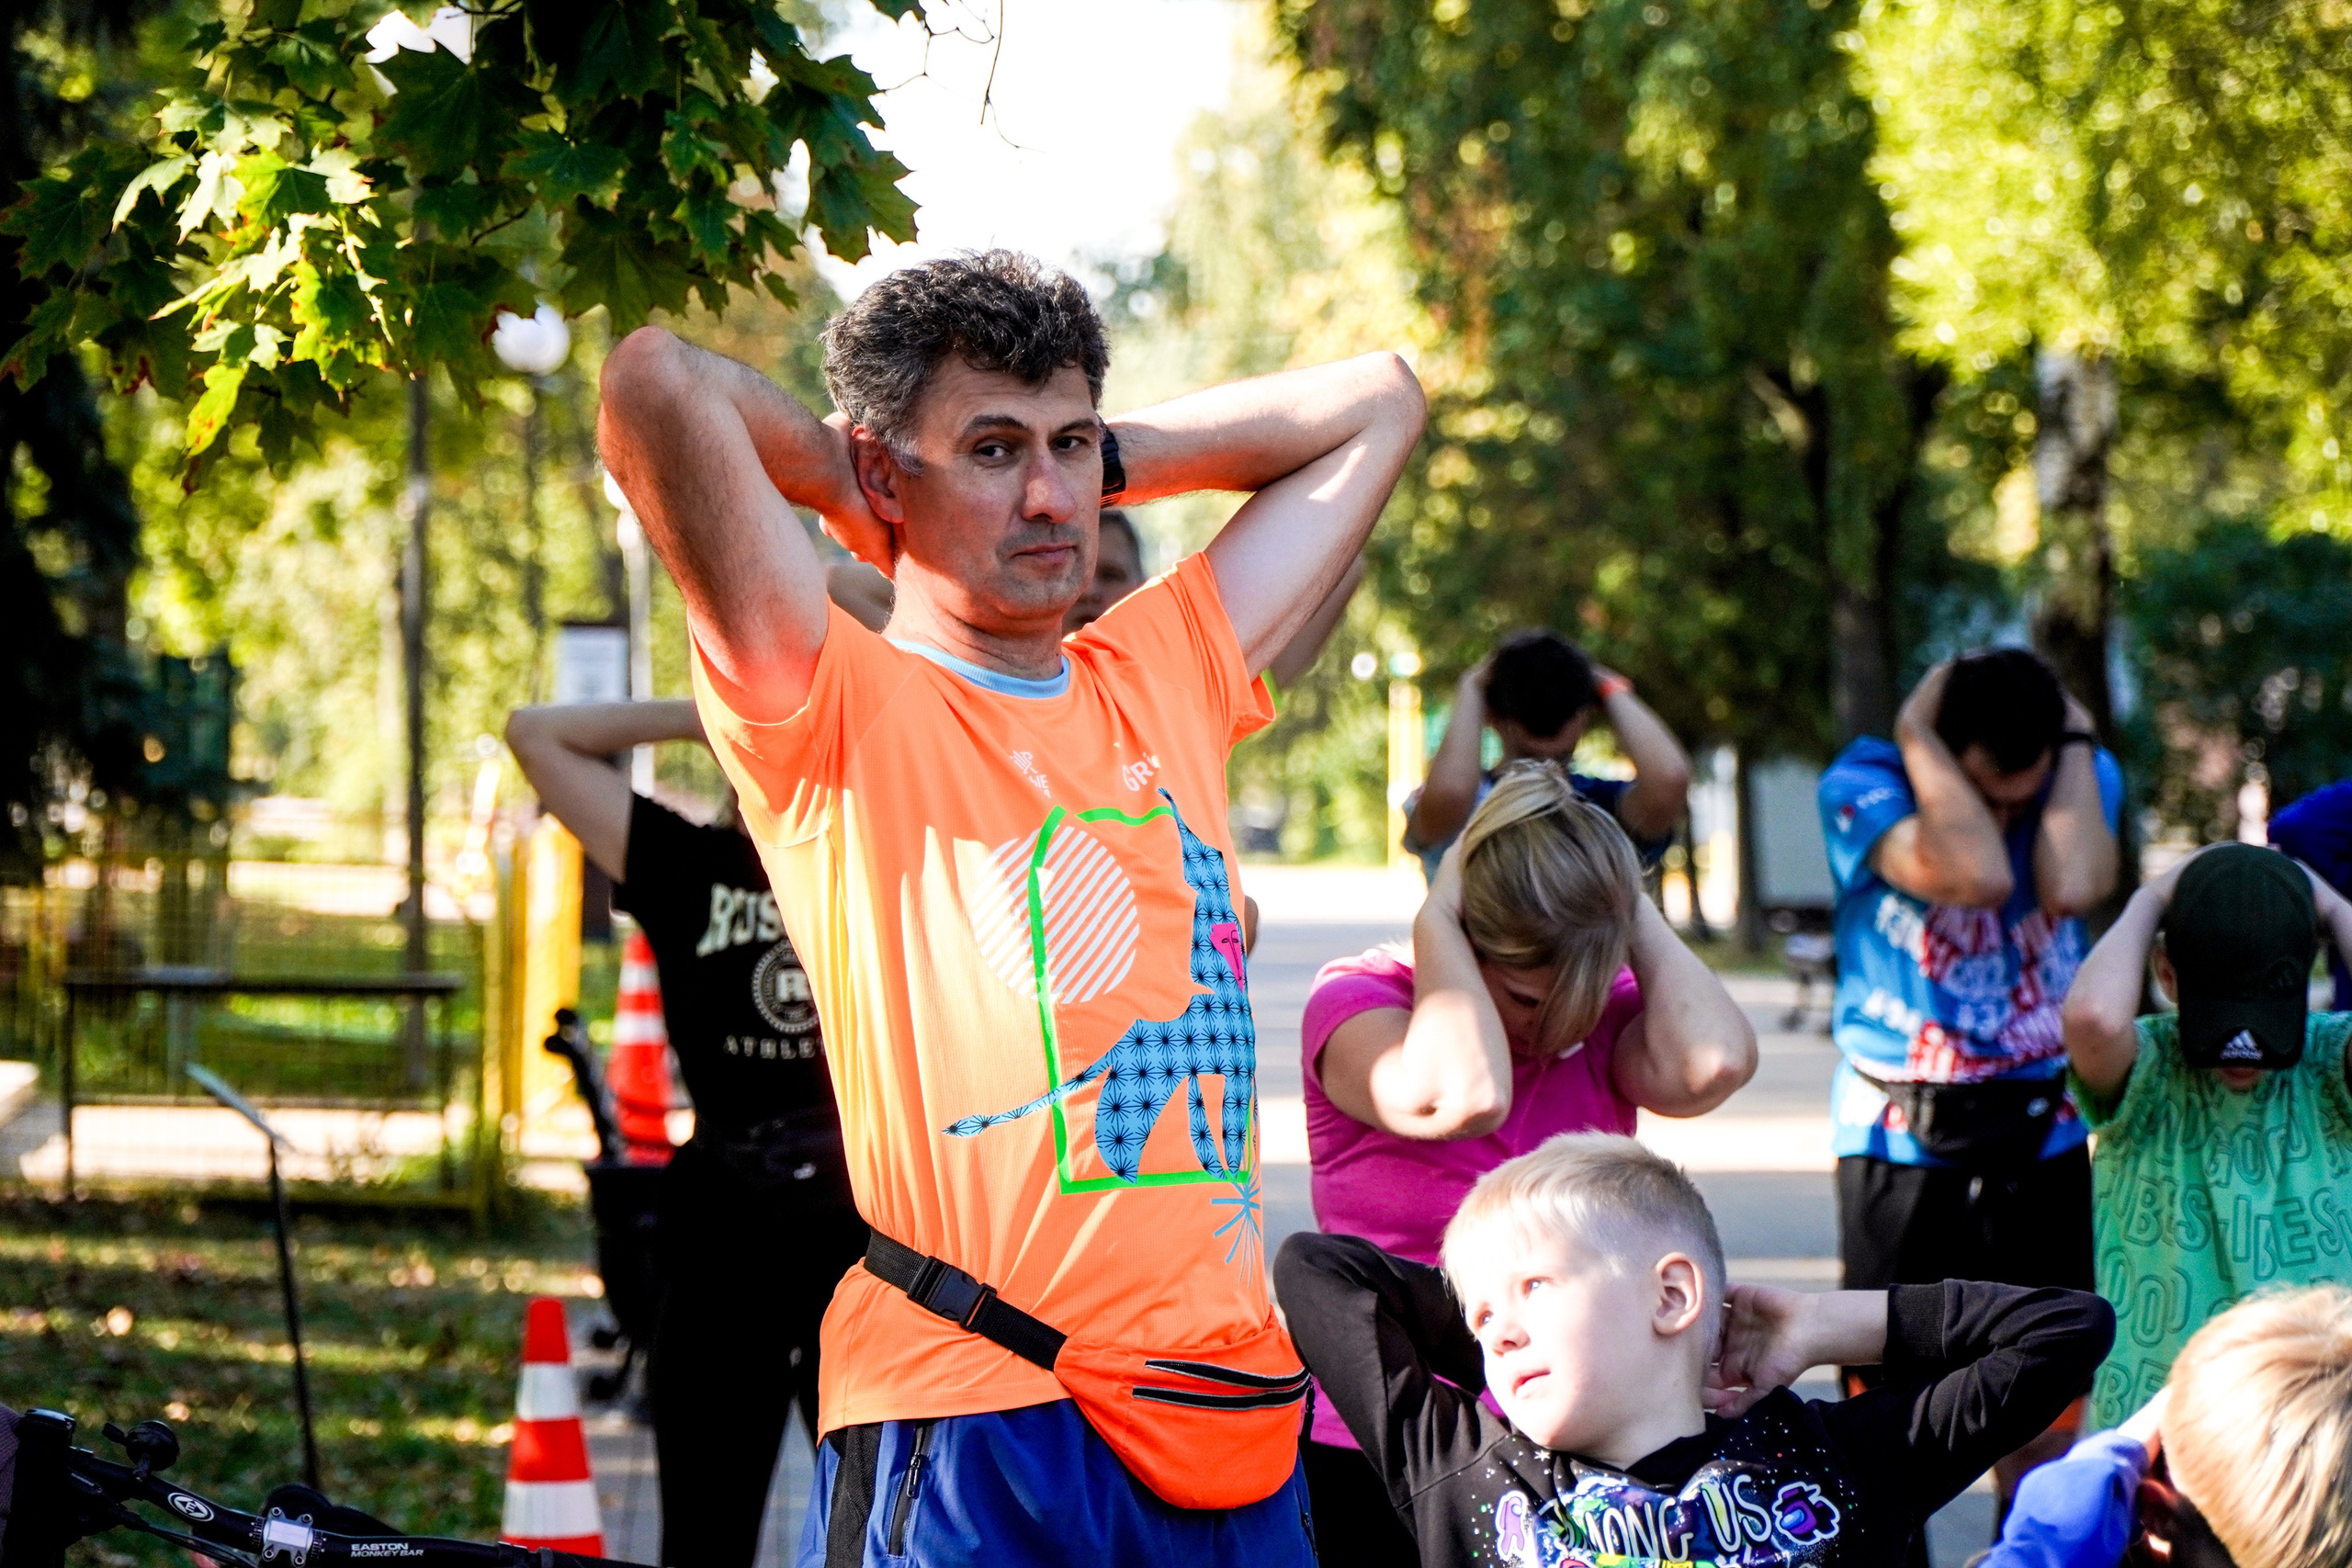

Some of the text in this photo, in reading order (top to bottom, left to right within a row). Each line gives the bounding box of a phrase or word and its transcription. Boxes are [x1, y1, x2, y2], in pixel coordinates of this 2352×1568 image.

[776, 967, 809, 1002] R
[723, 1034, 826, 1059] ATHLE
[1702, 1473, 1772, 1551] US
[350, 1549, 424, 1558] MONKEY BAR
[351, 1542, 409, 1551] EASTON
